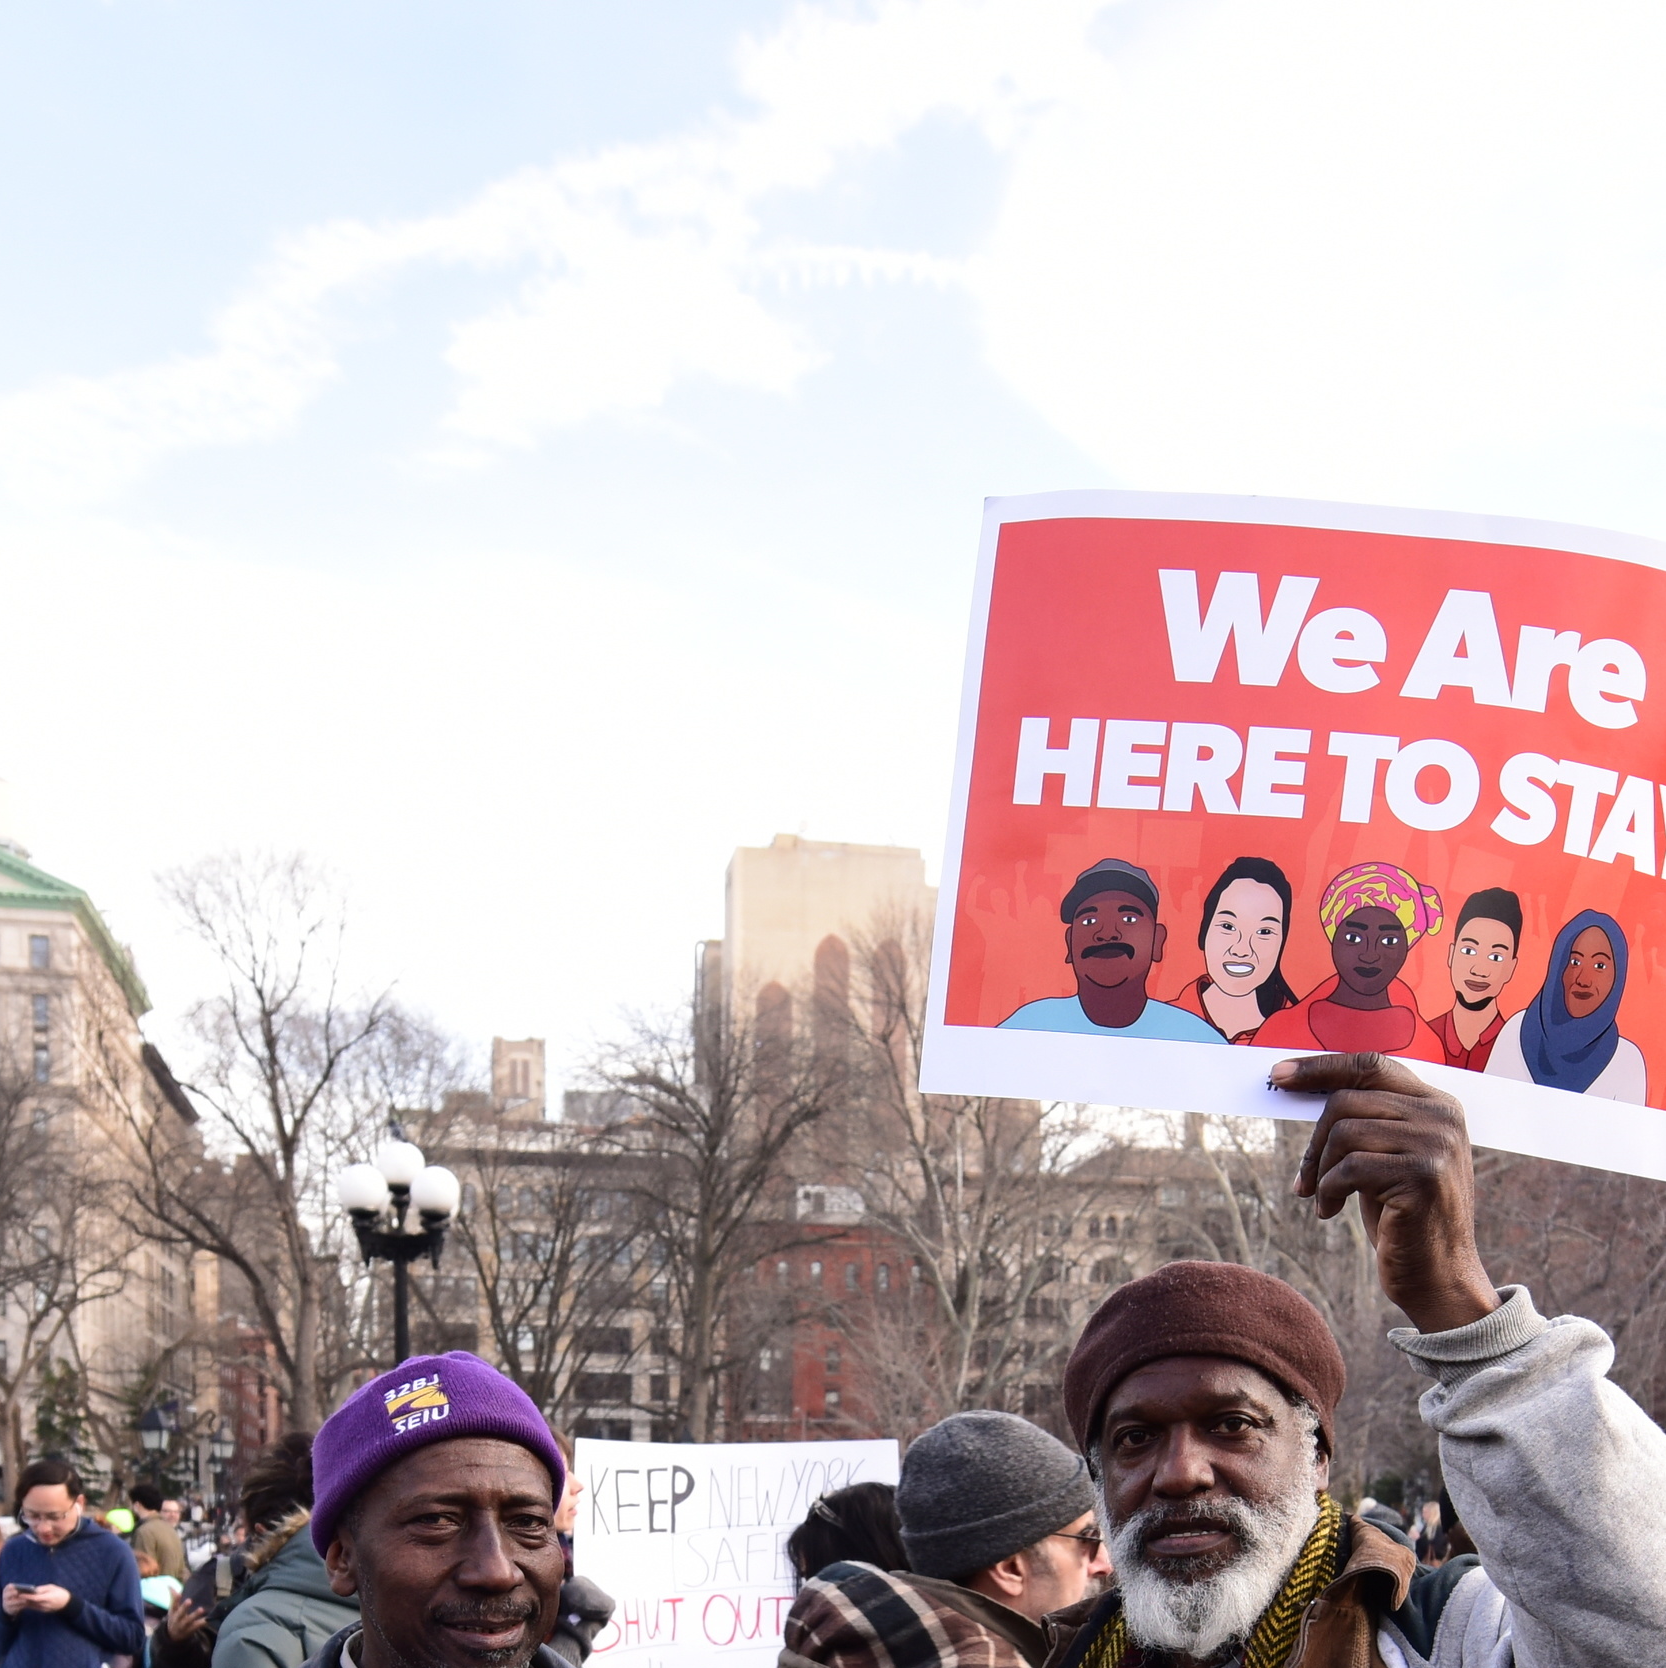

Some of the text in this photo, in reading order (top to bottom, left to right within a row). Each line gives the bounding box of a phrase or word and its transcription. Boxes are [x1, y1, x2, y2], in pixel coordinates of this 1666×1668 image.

[1159, 568, 1647, 730] We Are
[1013, 717, 1311, 819] HERE
[1328, 731, 1481, 832] TO
[384, 1373, 439, 1404] 32BJ
[395, 1404, 450, 1436] SEIU
[590, 1457, 866, 1535] KEEP NEW YORK
[684, 1531, 796, 1588] SAFE
[703, 1594, 795, 1646] OUT
